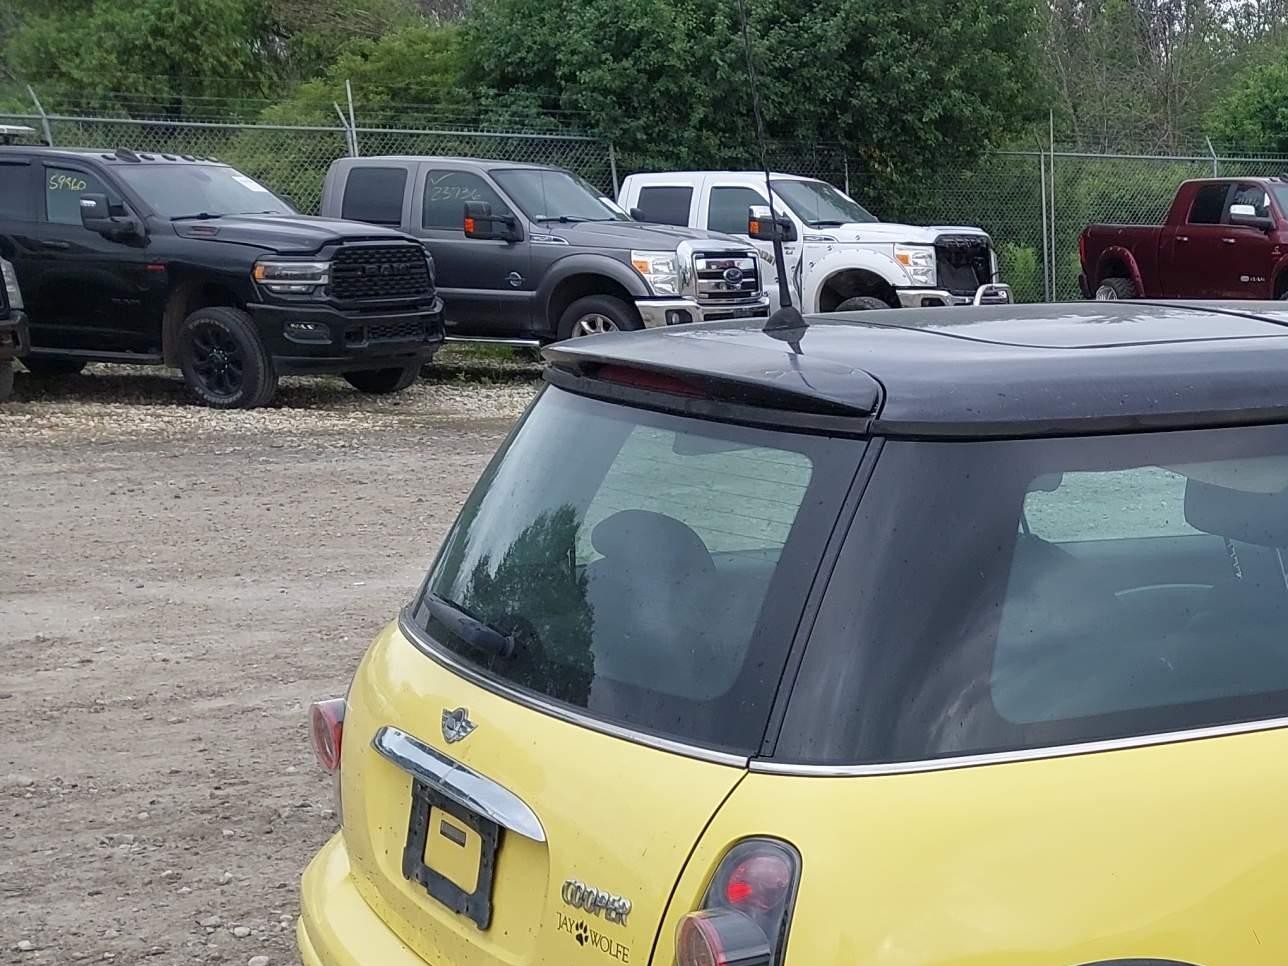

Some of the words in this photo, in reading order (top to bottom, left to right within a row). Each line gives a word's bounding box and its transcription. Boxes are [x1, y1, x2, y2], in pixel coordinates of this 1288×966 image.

[562, 880, 632, 927] COOPER
[557, 912, 575, 934] JAY
[590, 930, 629, 963] WOLFE
